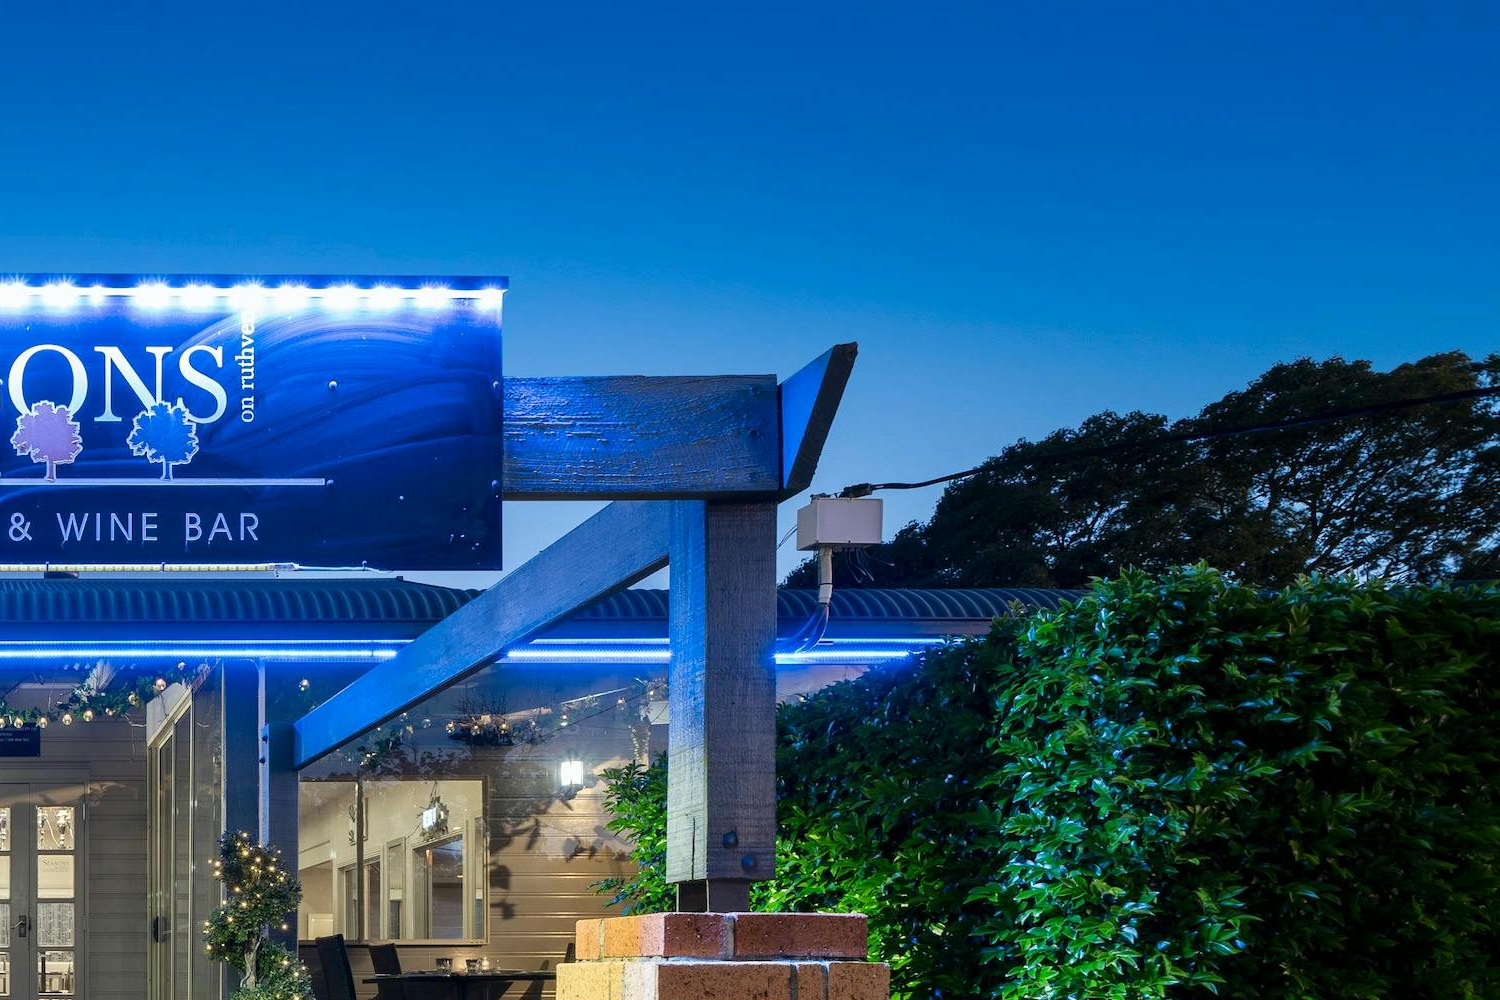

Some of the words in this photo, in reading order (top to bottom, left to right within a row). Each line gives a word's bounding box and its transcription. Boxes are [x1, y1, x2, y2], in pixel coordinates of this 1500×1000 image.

[234, 311, 255, 390] ruthve
[241, 396, 255, 423] on
[8, 512, 33, 542] &
[56, 512, 160, 542] WINE
[185, 512, 261, 542] BAR
